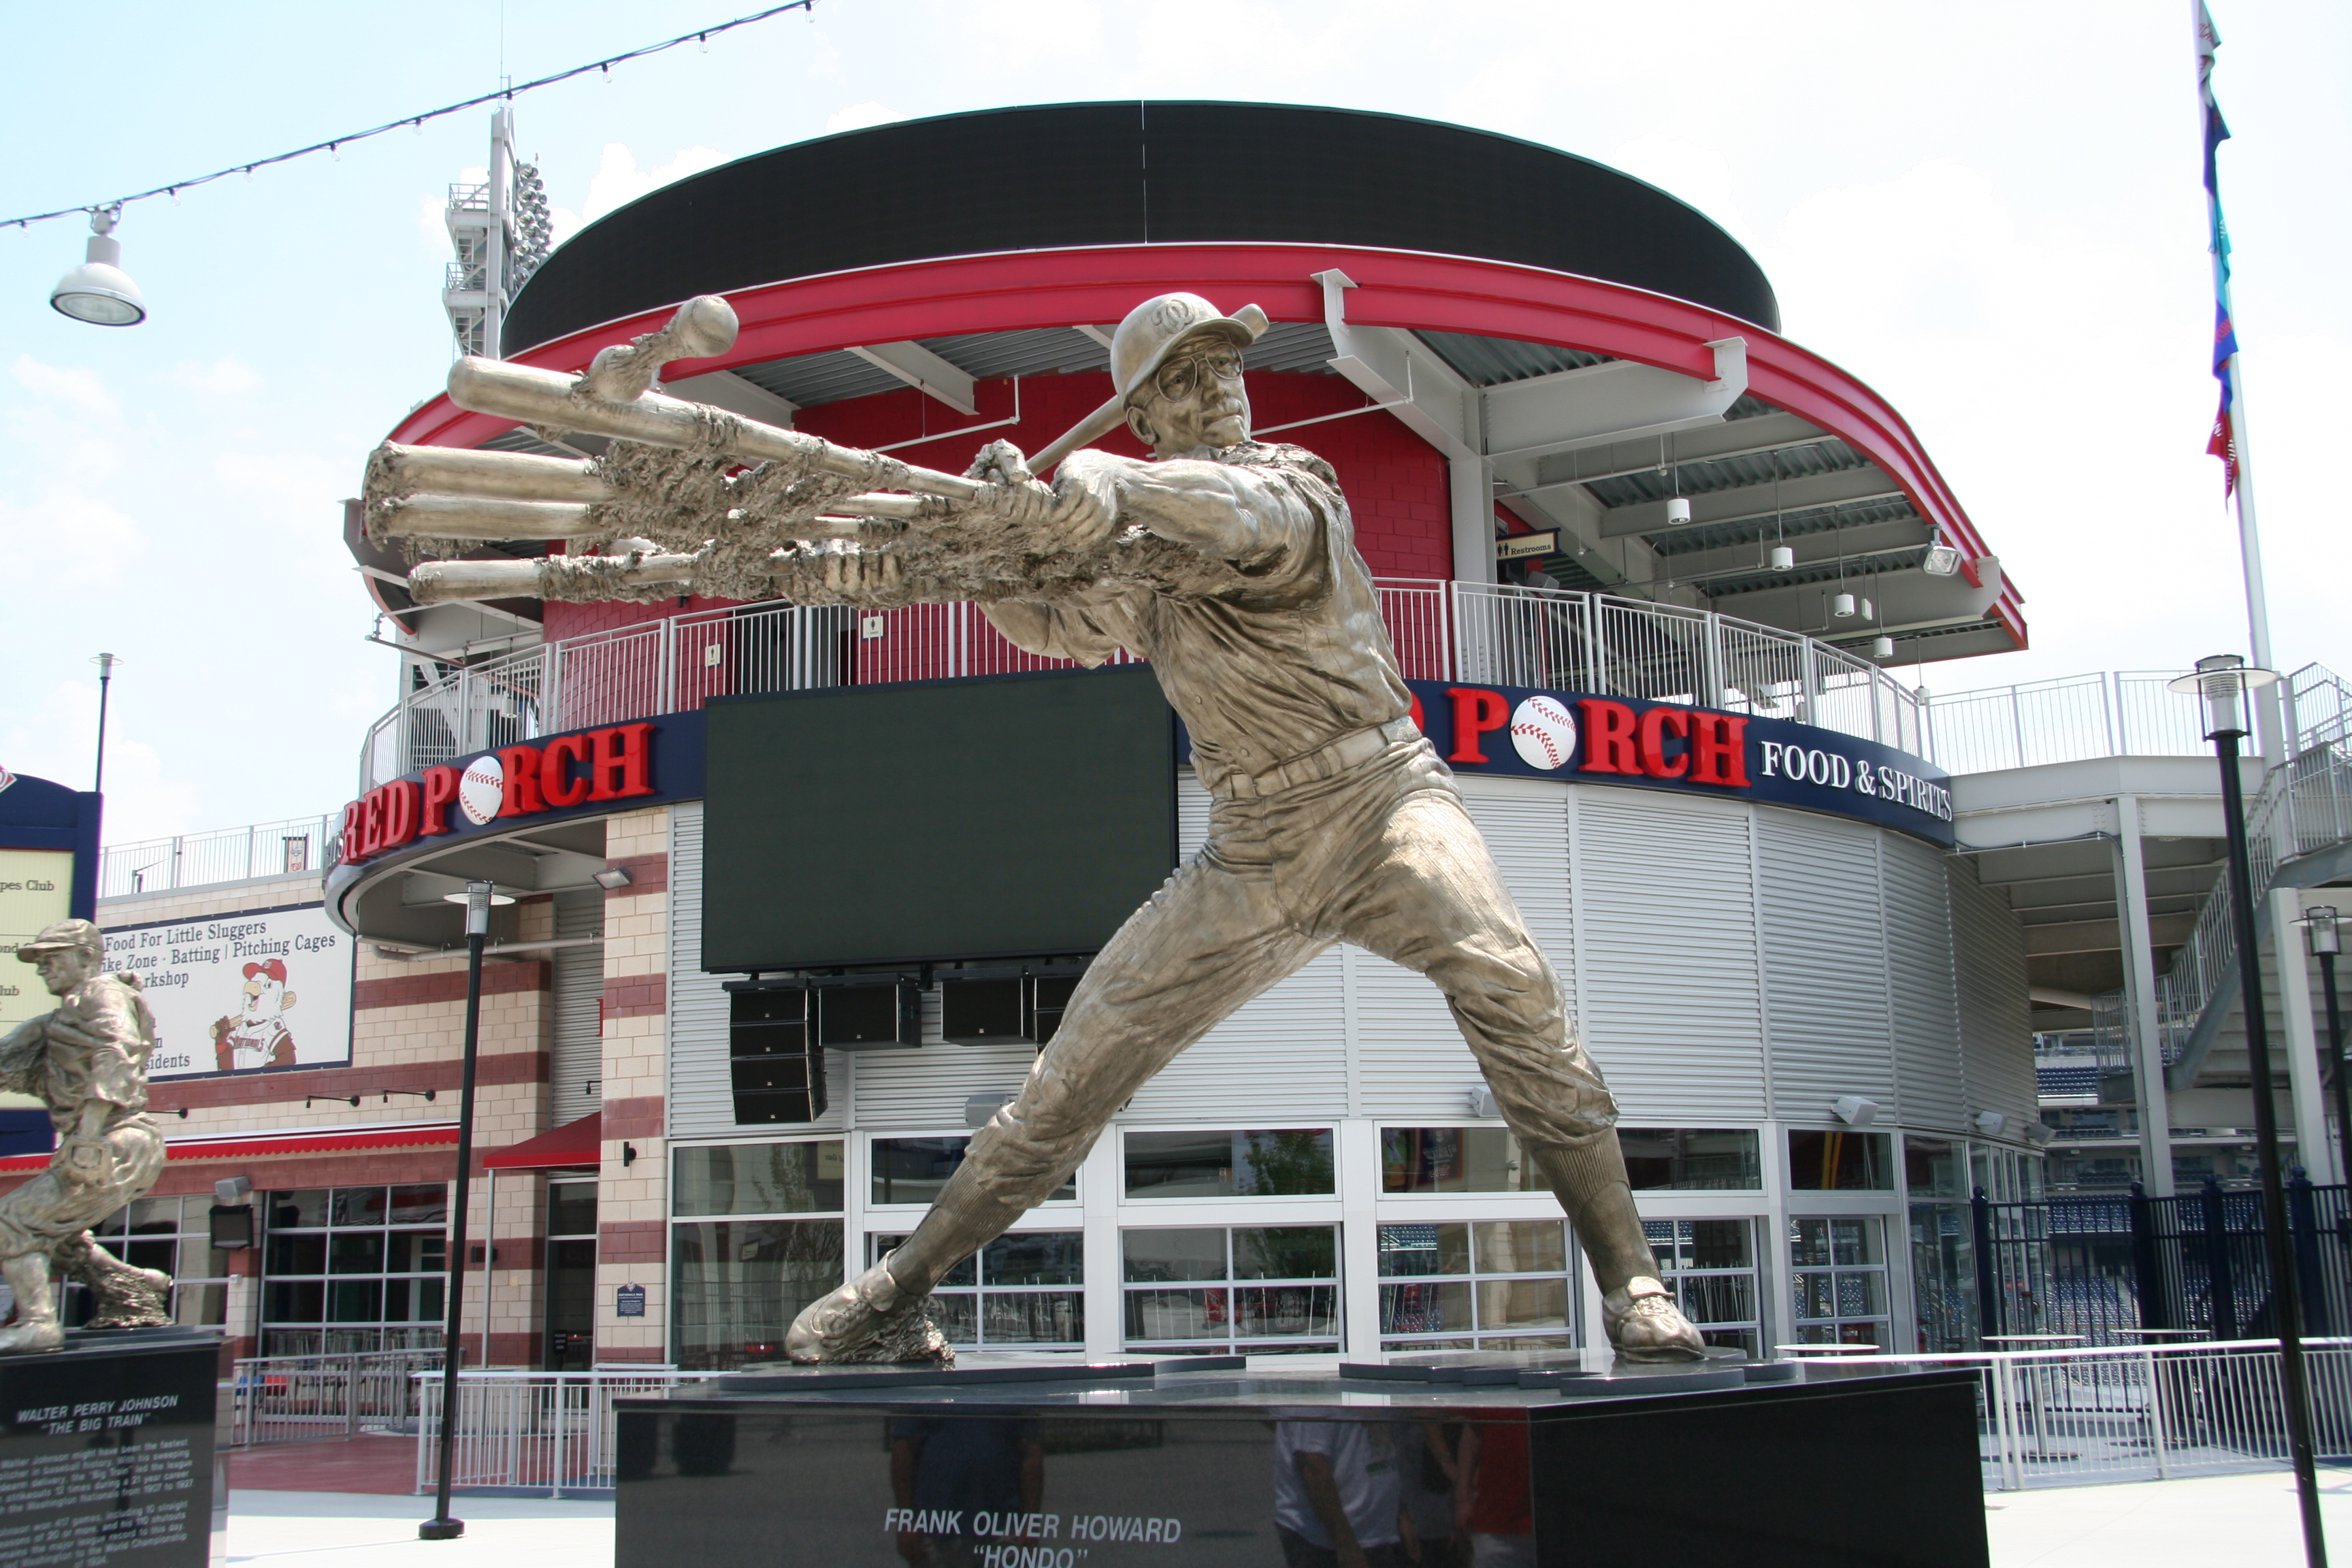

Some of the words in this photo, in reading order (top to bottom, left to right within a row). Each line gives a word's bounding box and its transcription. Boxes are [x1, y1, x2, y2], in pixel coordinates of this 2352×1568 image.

[1511, 544, 1552, 555] Restrooms
[1758, 740, 1851, 789] FOOD
[1855, 760, 1876, 796] &
[1877, 766, 1953, 822] SPIRITS
[339, 780, 420, 866] RED
[26, 879, 54, 891] Club
[104, 934, 136, 952] Food
[140, 932, 163, 948] For
[167, 926, 202, 945] Little
[208, 921, 267, 942] Sluggers
[127, 954, 158, 970] Zone
[172, 947, 220, 964] Batting
[233, 937, 291, 958] Pitching
[295, 934, 336, 954] Cages
[16, 1405, 69, 1424] WALTER
[72, 1400, 116, 1418] PERRY
[118, 1394, 180, 1413] JOHNSON
[78, 1417, 103, 1432] BIG
[31, 1454, 69, 1466] Johnson
[70, 1449, 97, 1461] might
[98, 1448, 118, 1456] have
[120, 1444, 142, 1454] been
[144, 1442, 158, 1451] the
[159, 1438, 189, 1450] fastest
[42, 1461, 81, 1475] baseball
[152, 1450, 191, 1461] sweeping
[70, 1473, 86, 1482] the
[135, 1463, 150, 1473] led
[150, 1463, 165, 1471] the
[165, 1459, 193, 1471] league
[5, 1488, 52, 1503] strikeouts
[67, 1483, 92, 1494] times
[94, 1478, 121, 1491] during
[142, 1473, 162, 1486] year
[163, 1470, 190, 1482] career
[27, 1496, 78, 1511] Washington
[80, 1489, 120, 1503] Nationals
[121, 1486, 142, 1497] from
[163, 1483, 174, 1492] to
[32, 1521, 53, 1532] won
[105, 1507, 144, 1520] including
[157, 1499, 189, 1512] straight
[101, 1520, 119, 1532] and
[150, 1511, 186, 1524] shutouts
[885, 1508, 964, 1535] FRANK
[973, 1511, 1060, 1539] OLIVER
[1071, 1515, 1181, 1544] HOWARD
[48, 1539, 76, 1552] major
[76, 1534, 108, 1548] league
[108, 1529, 137, 1541] record
[138, 1527, 149, 1537] to
[150, 1524, 167, 1535] this
[103, 1540, 131, 1553] World
[131, 1531, 189, 1550] Championship
